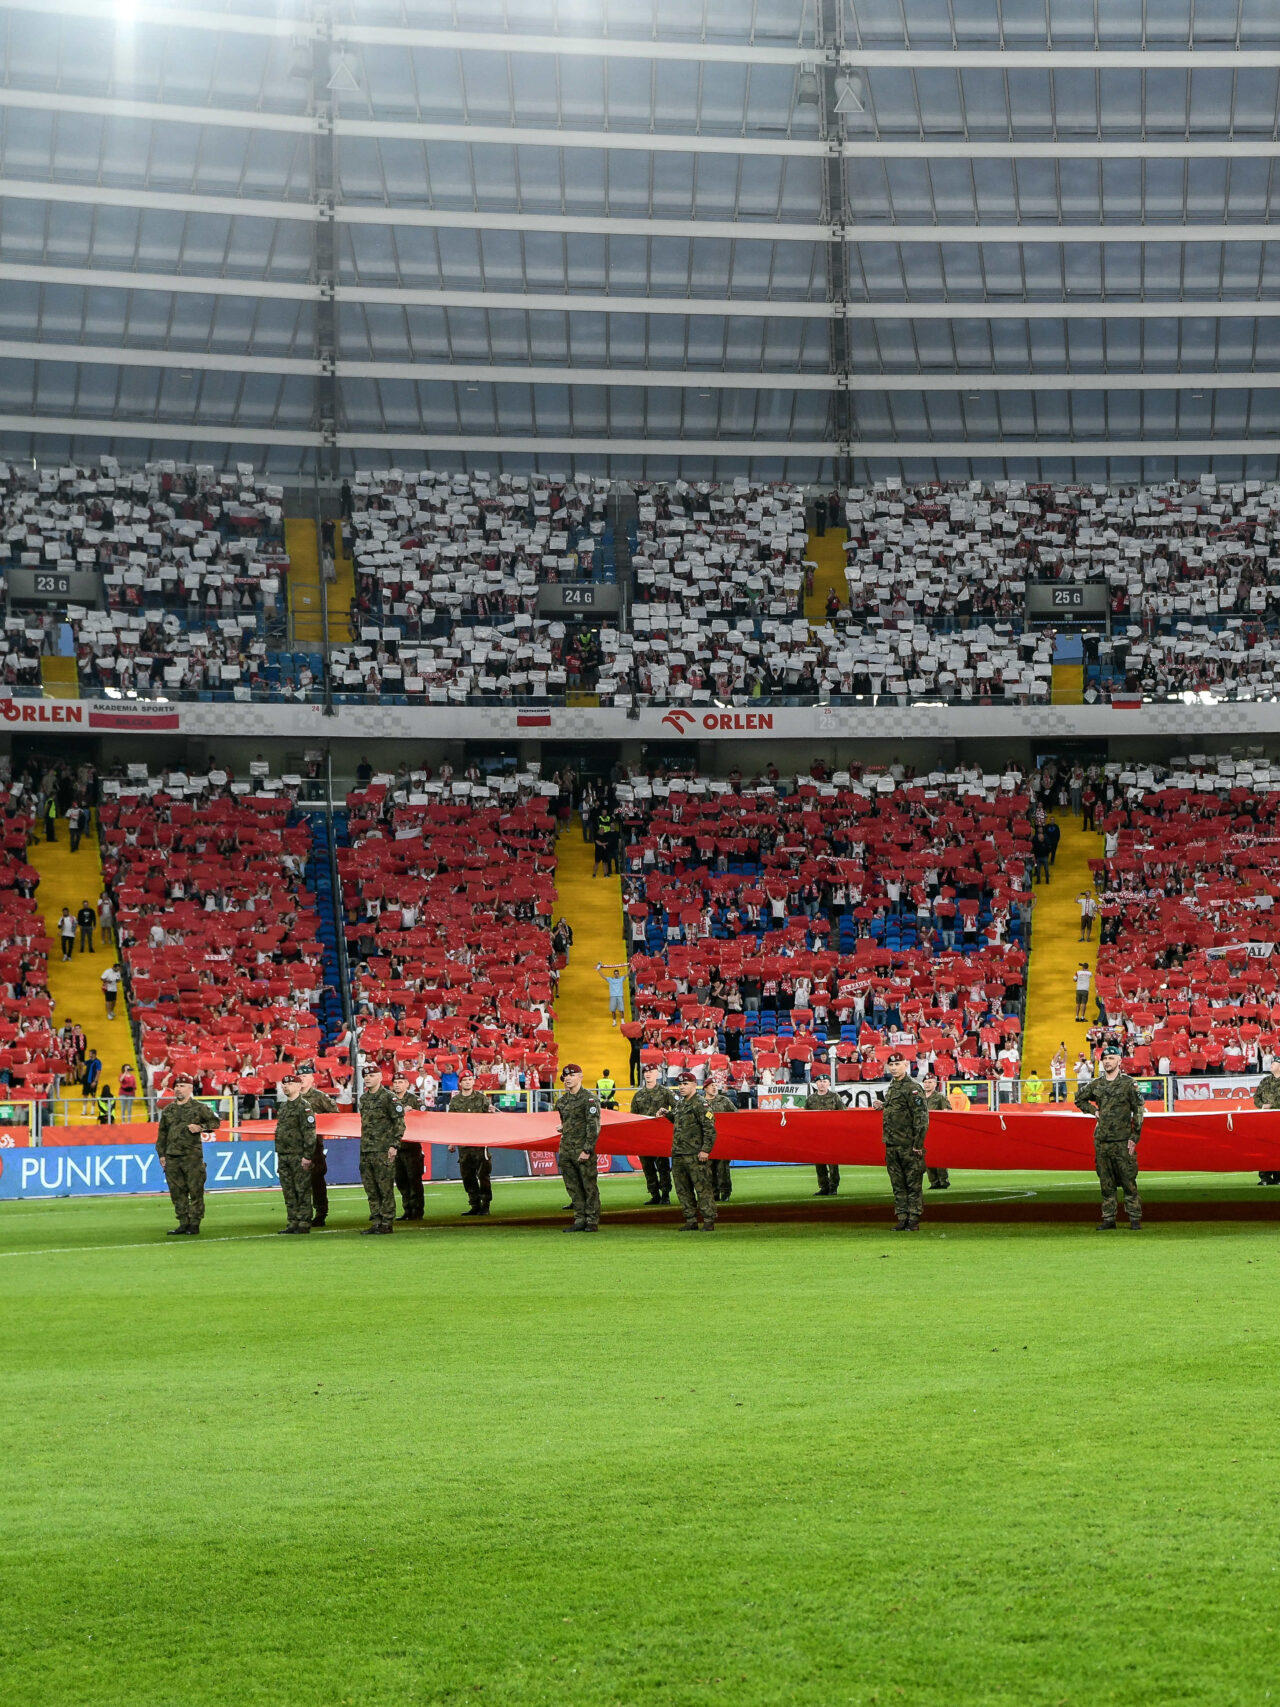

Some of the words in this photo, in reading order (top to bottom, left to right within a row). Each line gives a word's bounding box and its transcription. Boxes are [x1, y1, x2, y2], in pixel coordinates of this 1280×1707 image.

[37, 577, 55, 591] 23
[58, 580, 67, 591] G
[565, 590, 581, 603] 24
[584, 592, 592, 603] G
[1055, 591, 1070, 604] 25
[1073, 593, 1081, 603] G
[4, 704, 82, 723] ORLEN
[93, 704, 138, 712] AKADEMIA
[141, 704, 175, 713] SPORTU
[702, 713, 773, 730] ORLEN
[819, 715, 836, 729] 25
[767, 1086, 800, 1094] KOWARY
[531, 1151, 555, 1159] ORLEN
[21, 1153, 155, 1190] PUNKTY
